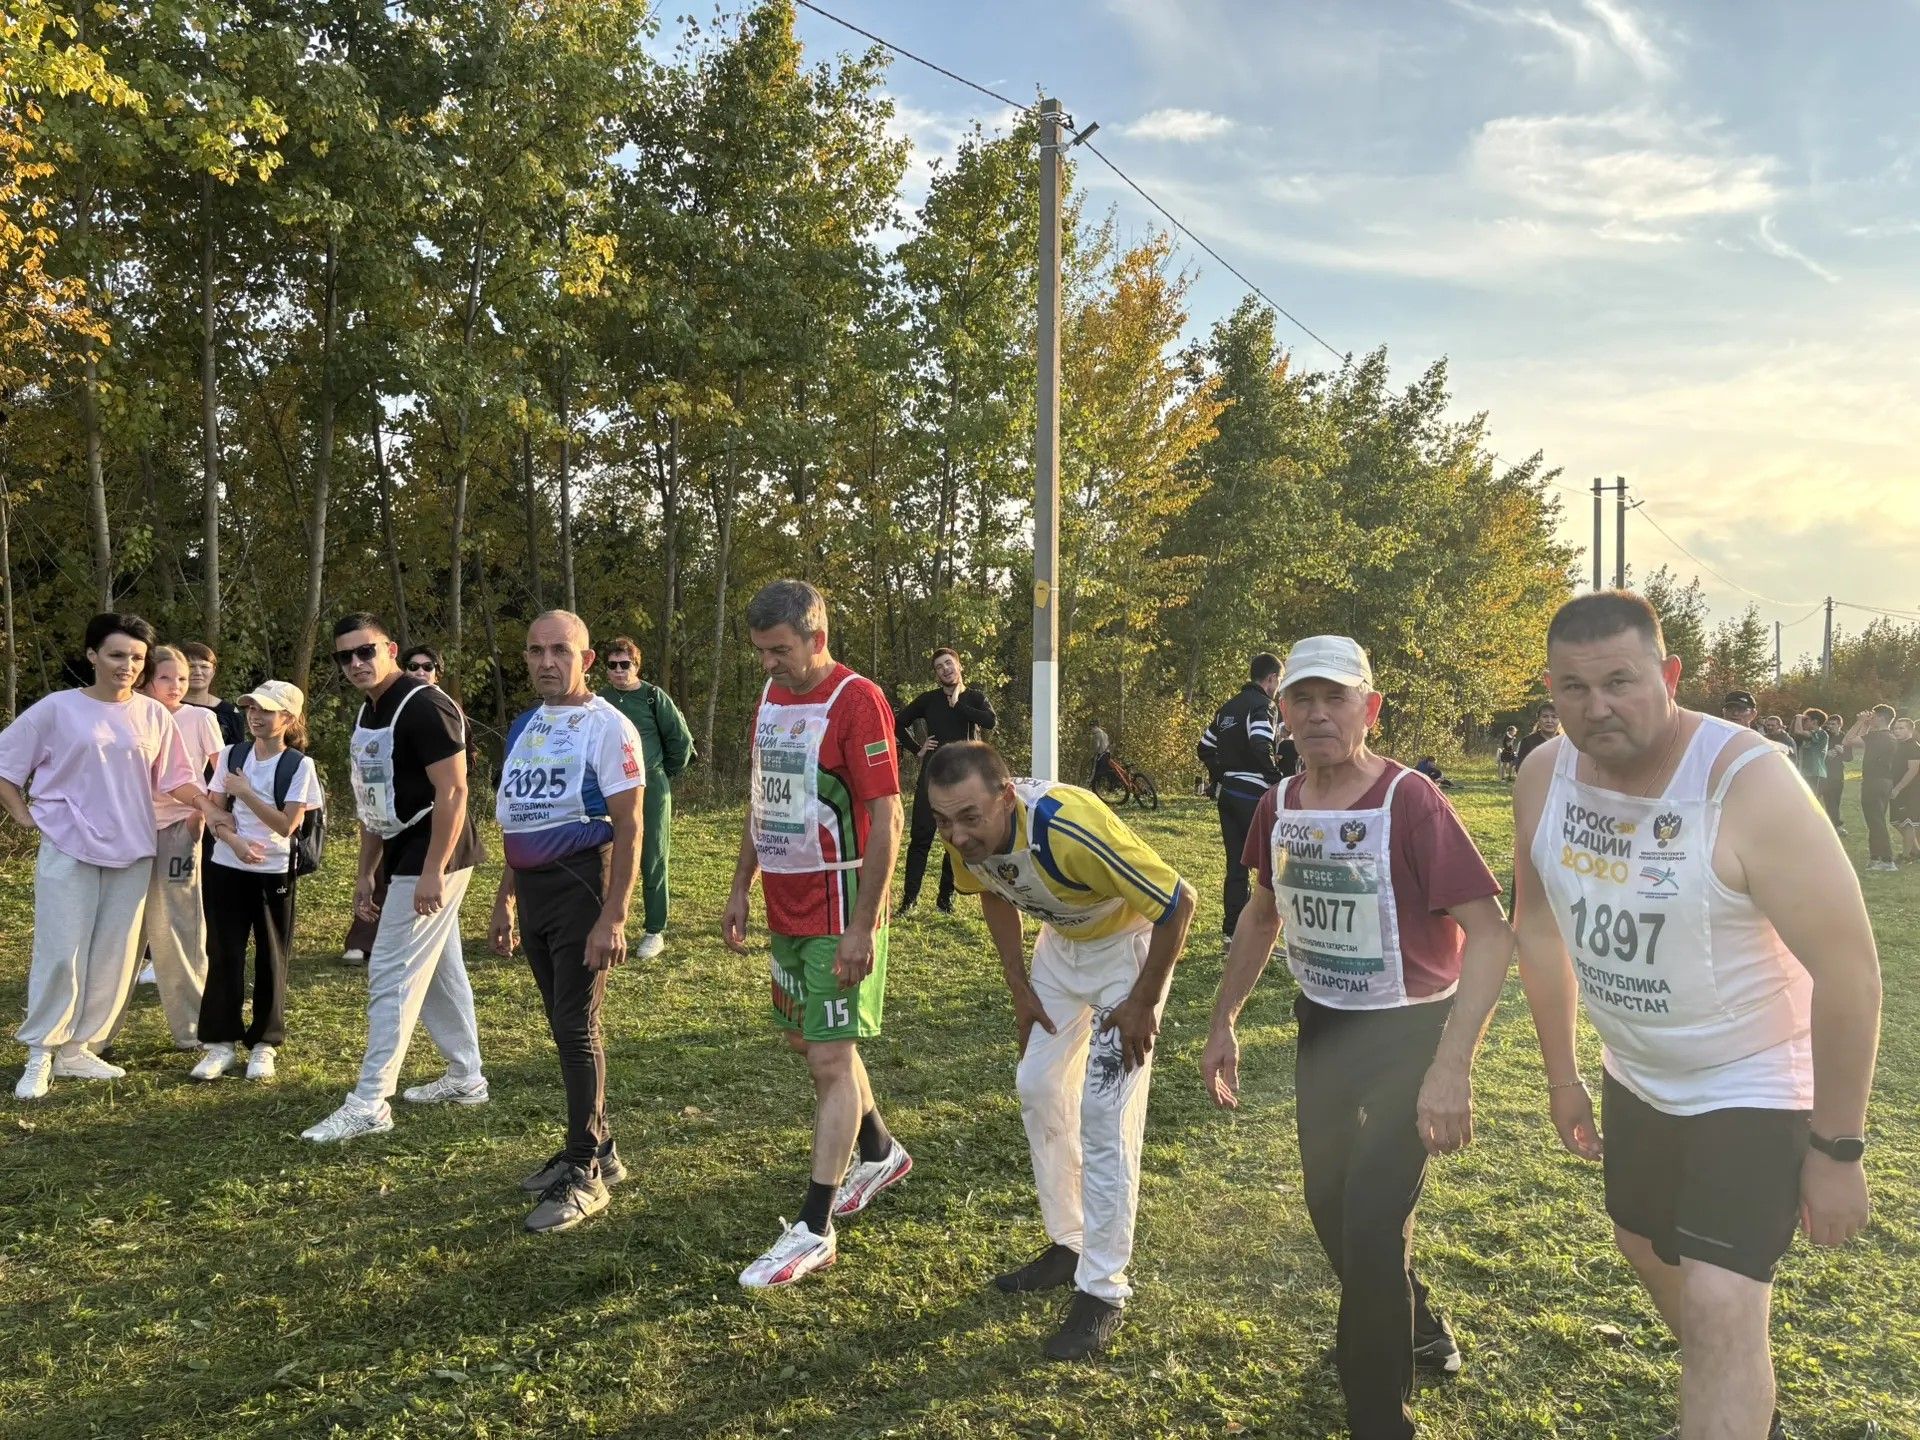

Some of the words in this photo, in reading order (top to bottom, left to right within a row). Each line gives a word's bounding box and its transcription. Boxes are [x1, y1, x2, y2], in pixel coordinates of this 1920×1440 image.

[504, 767, 567, 799] 2025
[510, 812, 550, 822] ТАТАРСТАН
[1280, 822, 1310, 840] КРОСС
[1566, 802, 1615, 835] КРОСС
[1563, 821, 1632, 858] НАЦИИ
[169, 856, 195, 877] 04
[1303, 869, 1333, 881] КРОСС
[1561, 844, 1628, 884] 2020
[1292, 893, 1356, 933] 15077
[1570, 896, 1666, 965] 1897
[1304, 969, 1369, 992] ТАТАРСТАН
[1576, 957, 1671, 994] РЕСПУБЛИКА
[1581, 978, 1669, 1013] ТАТАРСТАН
[824, 998, 849, 1028] 15
